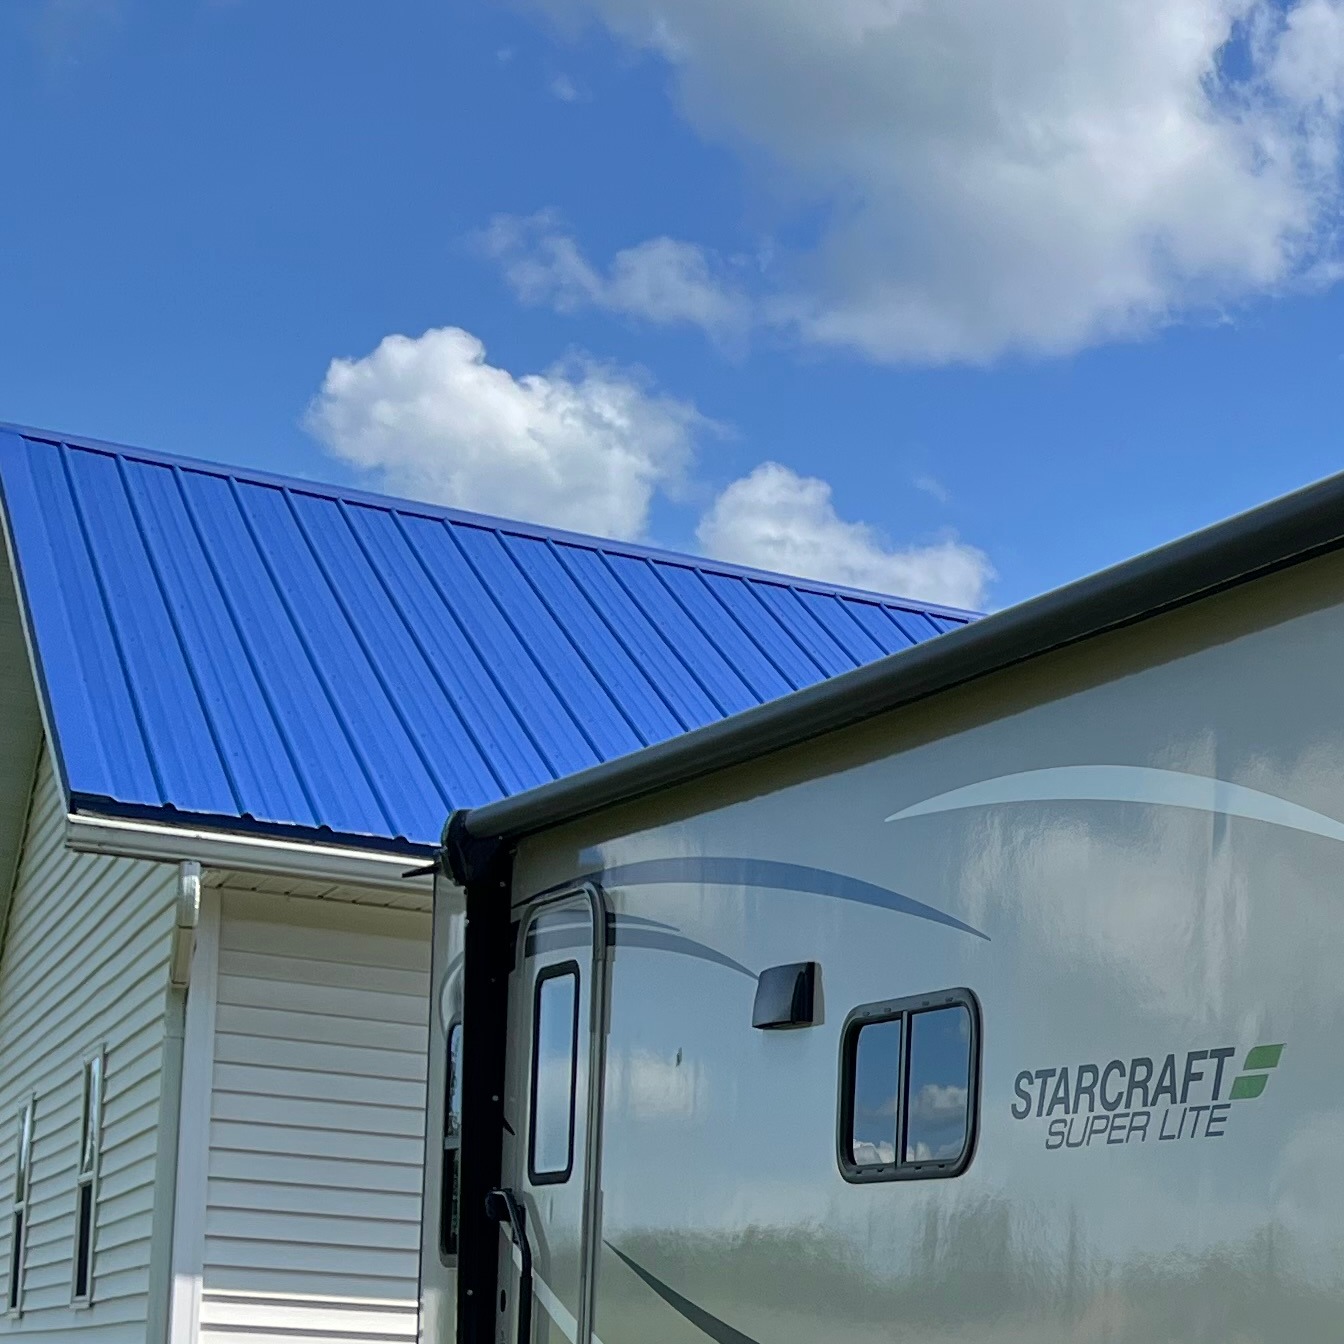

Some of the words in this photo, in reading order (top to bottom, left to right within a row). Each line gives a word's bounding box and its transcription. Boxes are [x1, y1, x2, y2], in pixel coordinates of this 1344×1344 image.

[1011, 1046, 1236, 1120] STARCRAFT
[1045, 1110, 1151, 1150] SUPER
[1158, 1103, 1232, 1141] LITE
